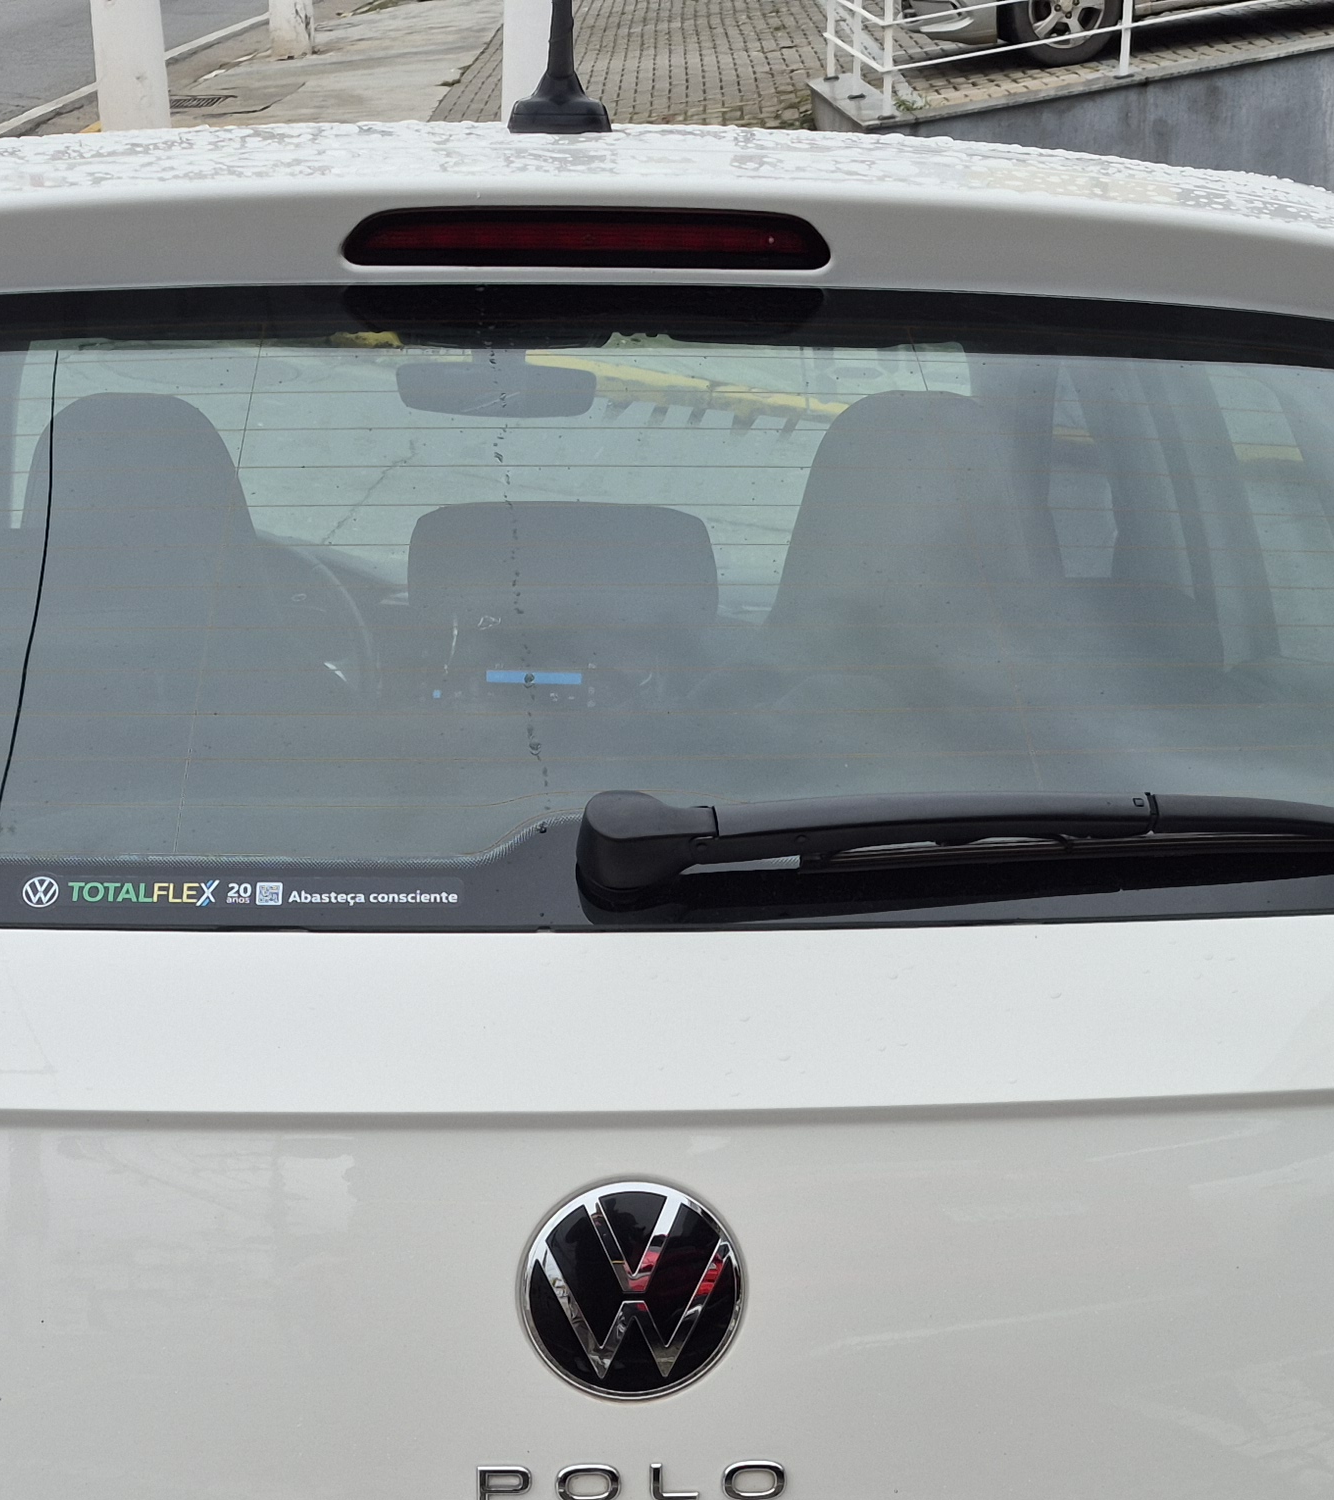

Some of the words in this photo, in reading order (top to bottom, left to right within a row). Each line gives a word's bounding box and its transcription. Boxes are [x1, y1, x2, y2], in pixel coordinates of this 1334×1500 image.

[68, 880, 220, 906] TOTALFLEX
[227, 882, 252, 898] 20
[288, 890, 366, 906] Abasteça
[369, 889, 459, 903] consciente
[519, 1178, 745, 1401] VW
